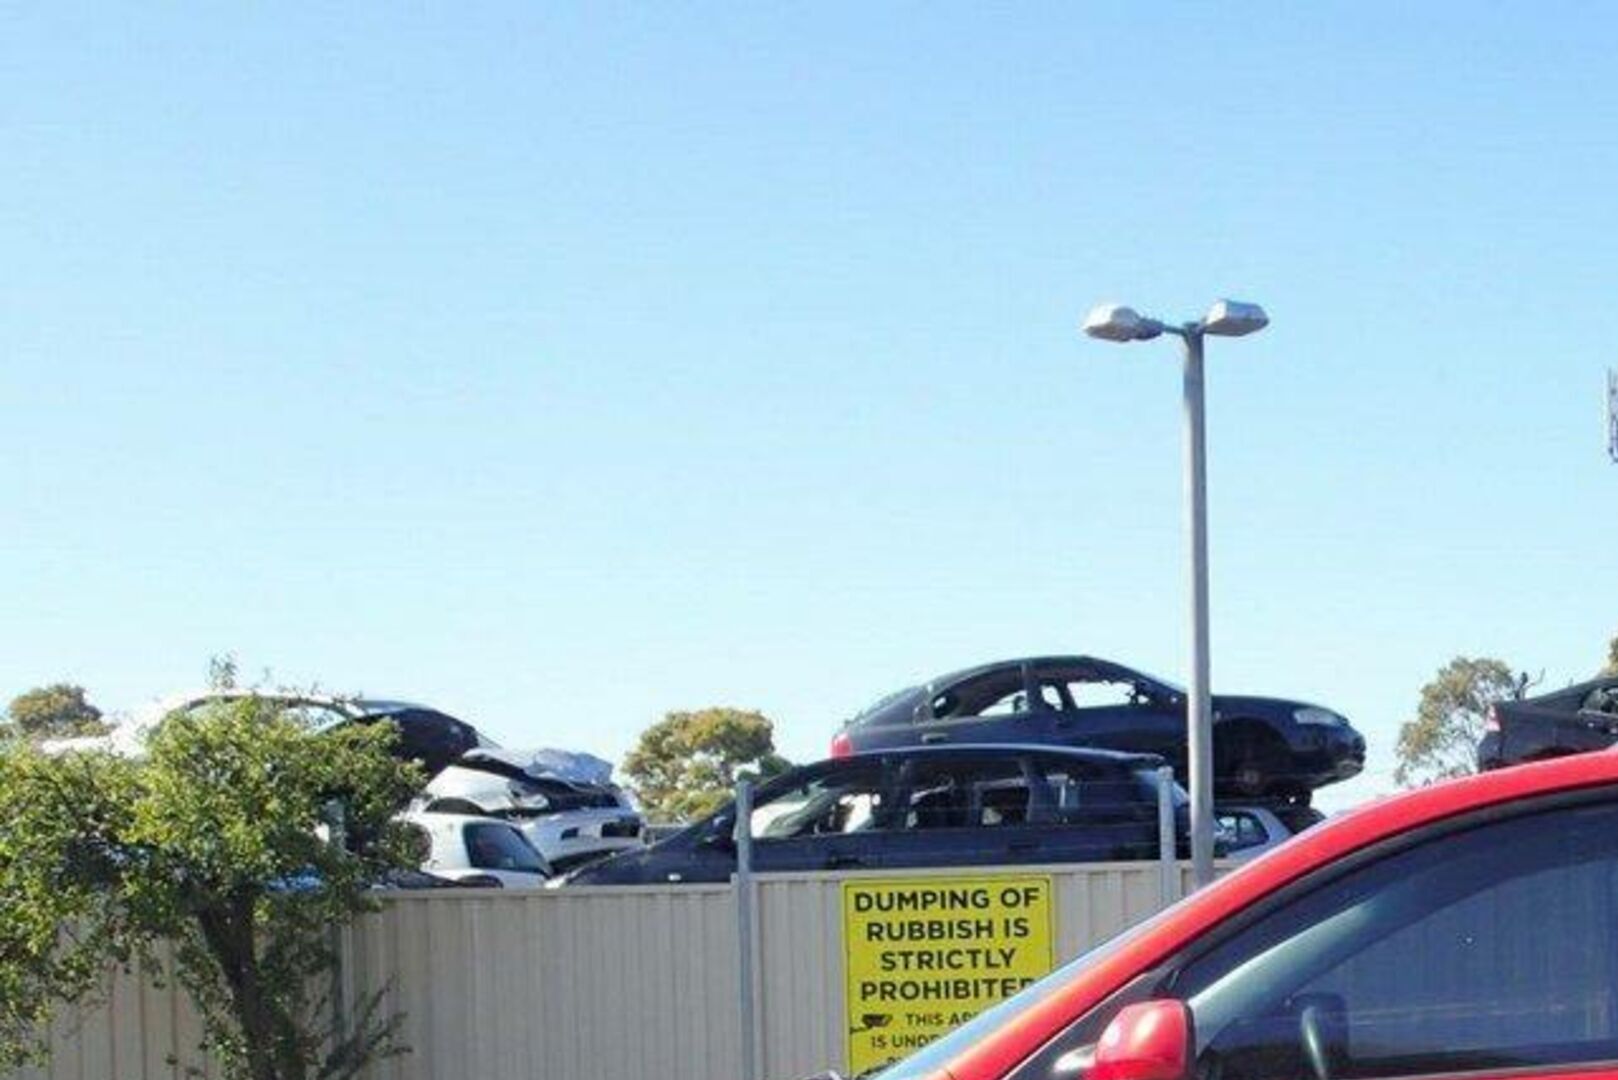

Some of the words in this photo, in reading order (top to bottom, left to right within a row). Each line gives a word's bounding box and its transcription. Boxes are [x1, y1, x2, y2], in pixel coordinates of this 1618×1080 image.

[855, 889, 989, 912] DUMPING
[1001, 887, 1040, 908] OF
[867, 920, 994, 941] RUBBISH
[1004, 918, 1030, 937] IS
[881, 948, 1016, 971] STRICTLY
[905, 1012, 944, 1026] THIS
[871, 1035, 887, 1049] IS
